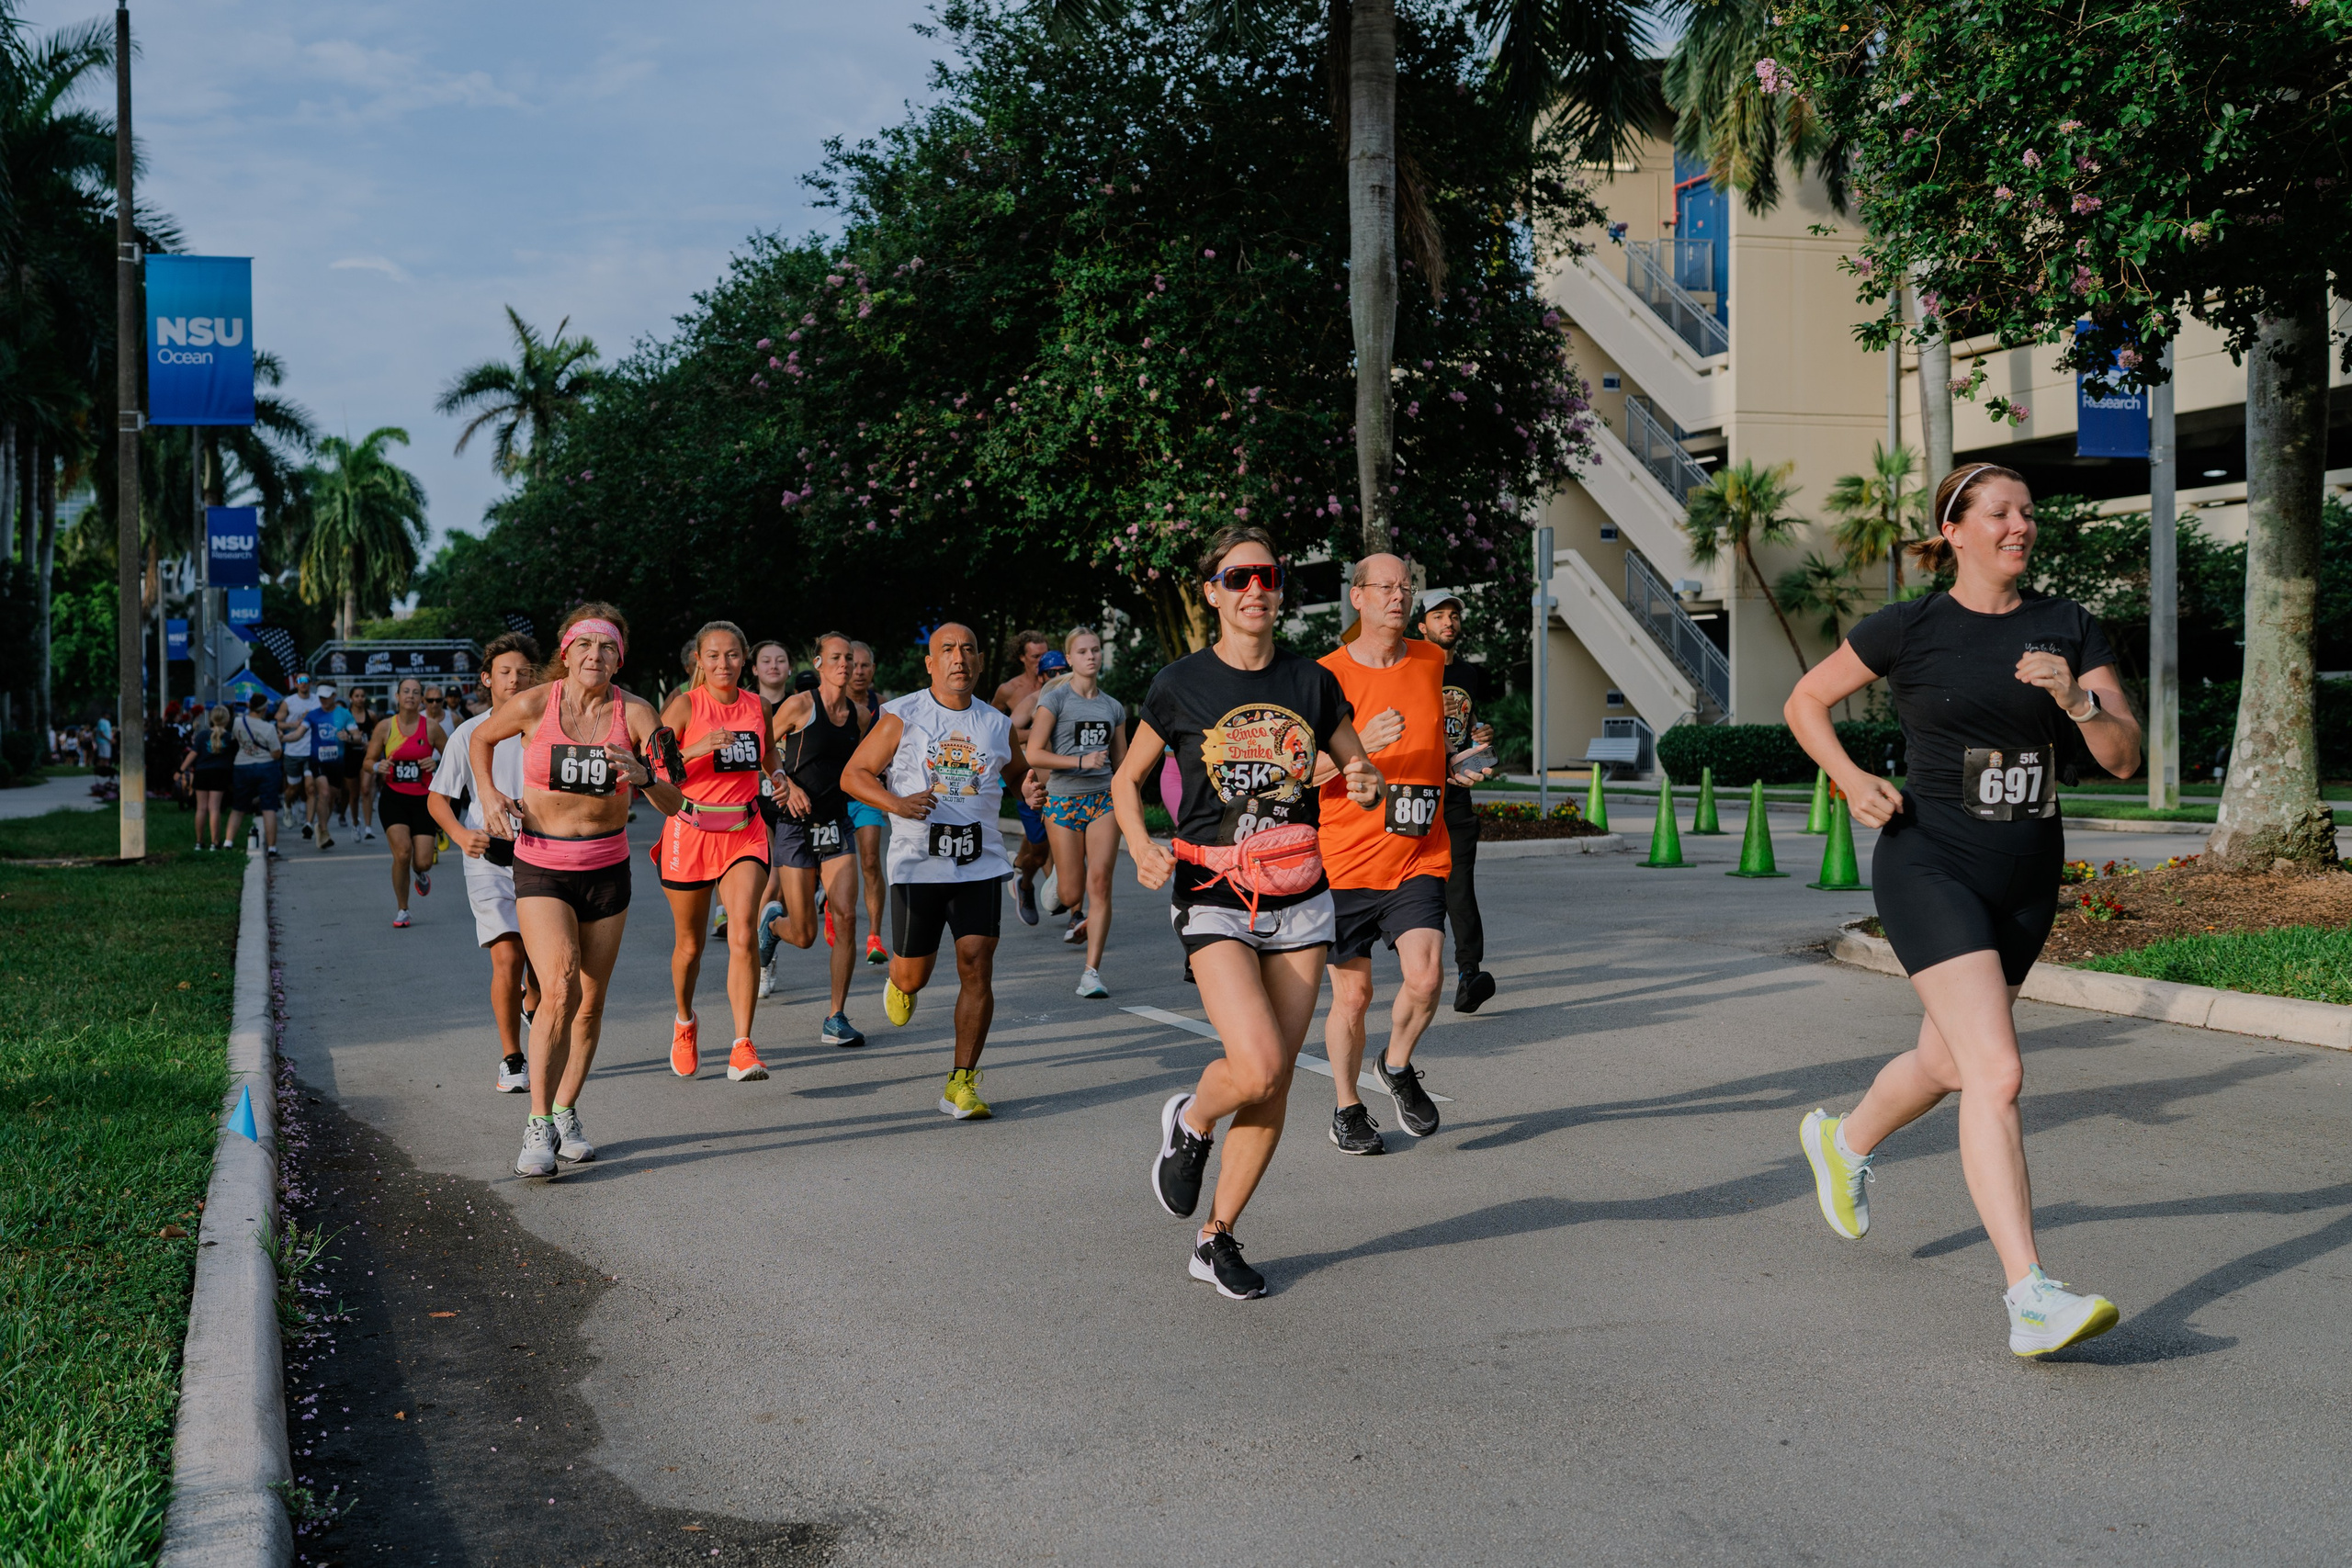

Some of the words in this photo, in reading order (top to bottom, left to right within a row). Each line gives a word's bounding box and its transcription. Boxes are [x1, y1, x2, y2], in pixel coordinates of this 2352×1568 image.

[156, 316, 243, 347] NSU
[157, 348, 214, 365] Ocean
[211, 536, 254, 551] NSU
[211, 551, 253, 559] Research
[231, 608, 259, 619] NSU
[410, 652, 425, 667] 5K
[1080, 728, 1107, 746] 852
[1226, 727, 1270, 741] Cinco
[590, 749, 605, 758] 5K
[719, 740, 757, 763] 965
[1228, 744, 1274, 760] Drinko
[2019, 752, 2040, 764] 5K
[396, 765, 419, 779] 520
[560, 758, 607, 785] 619
[1234, 763, 1272, 790] 5K
[949, 787, 960, 796] 5K
[1423, 788, 1434, 797] 5K
[1979, 765, 2043, 805] 697
[1272, 806, 1290, 818] 5K
[1395, 796, 1436, 825] 802
[673, 819, 682, 839] and
[810, 825, 840, 847] 729
[938, 833, 974, 857] 915
[670, 856, 680, 873] The
